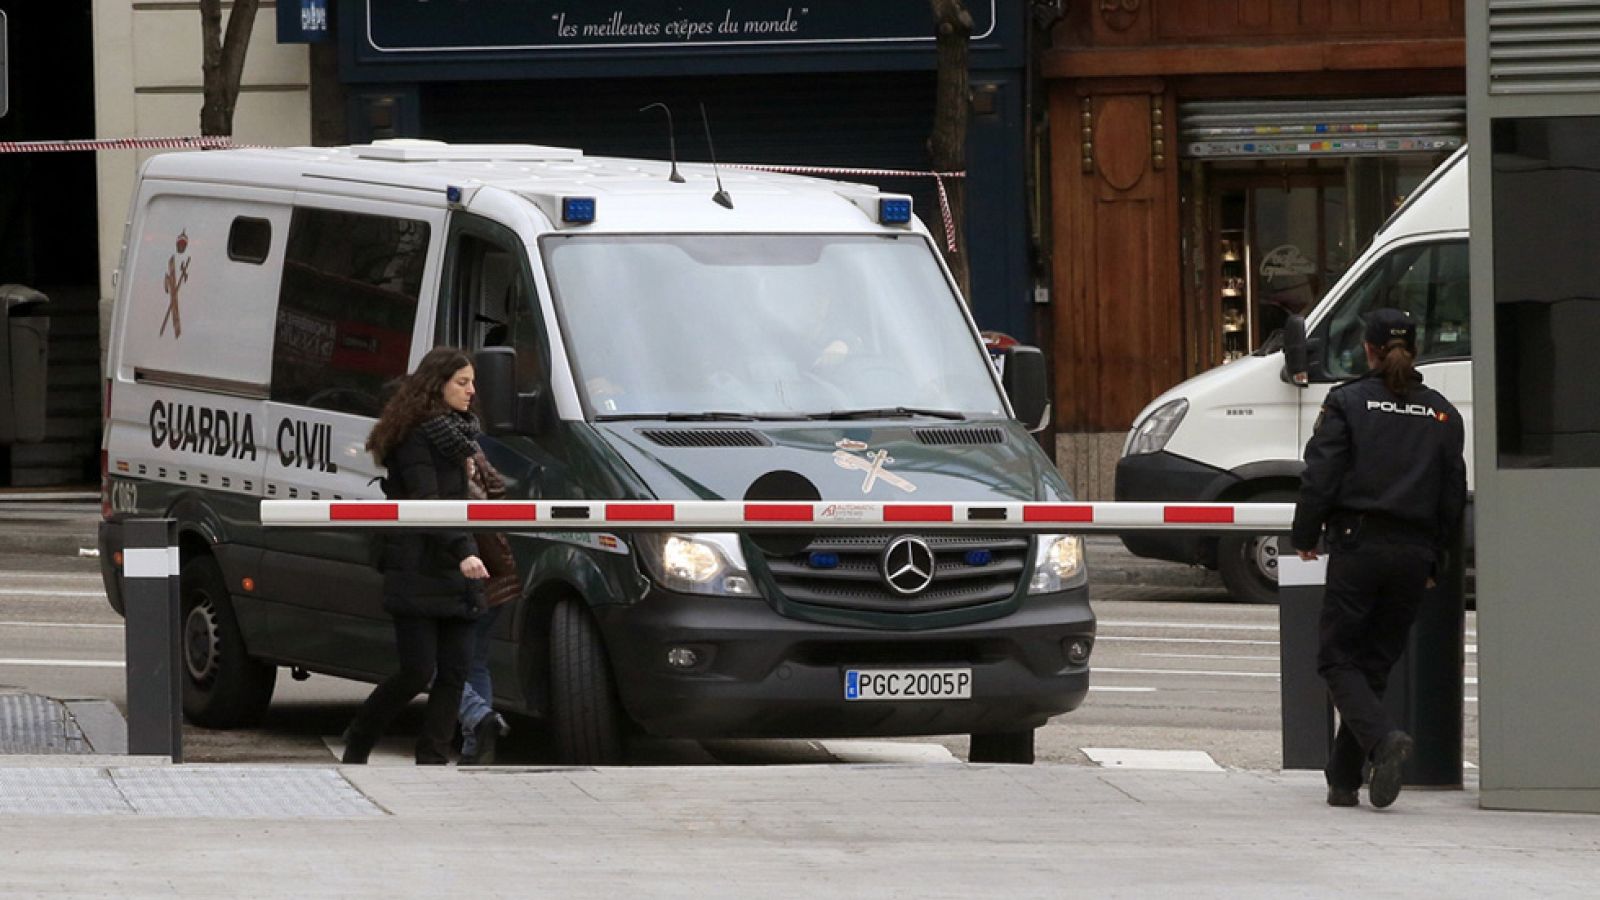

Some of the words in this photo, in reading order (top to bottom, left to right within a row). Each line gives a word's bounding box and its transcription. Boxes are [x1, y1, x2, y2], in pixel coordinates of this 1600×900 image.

[582, 10, 661, 36] meilleures
[665, 18, 714, 40] crêpes
[718, 8, 739, 33] du
[1366, 400, 1437, 419] POLICIA
[150, 399, 257, 462] GUARDIA
[276, 417, 338, 474] CIVIL
